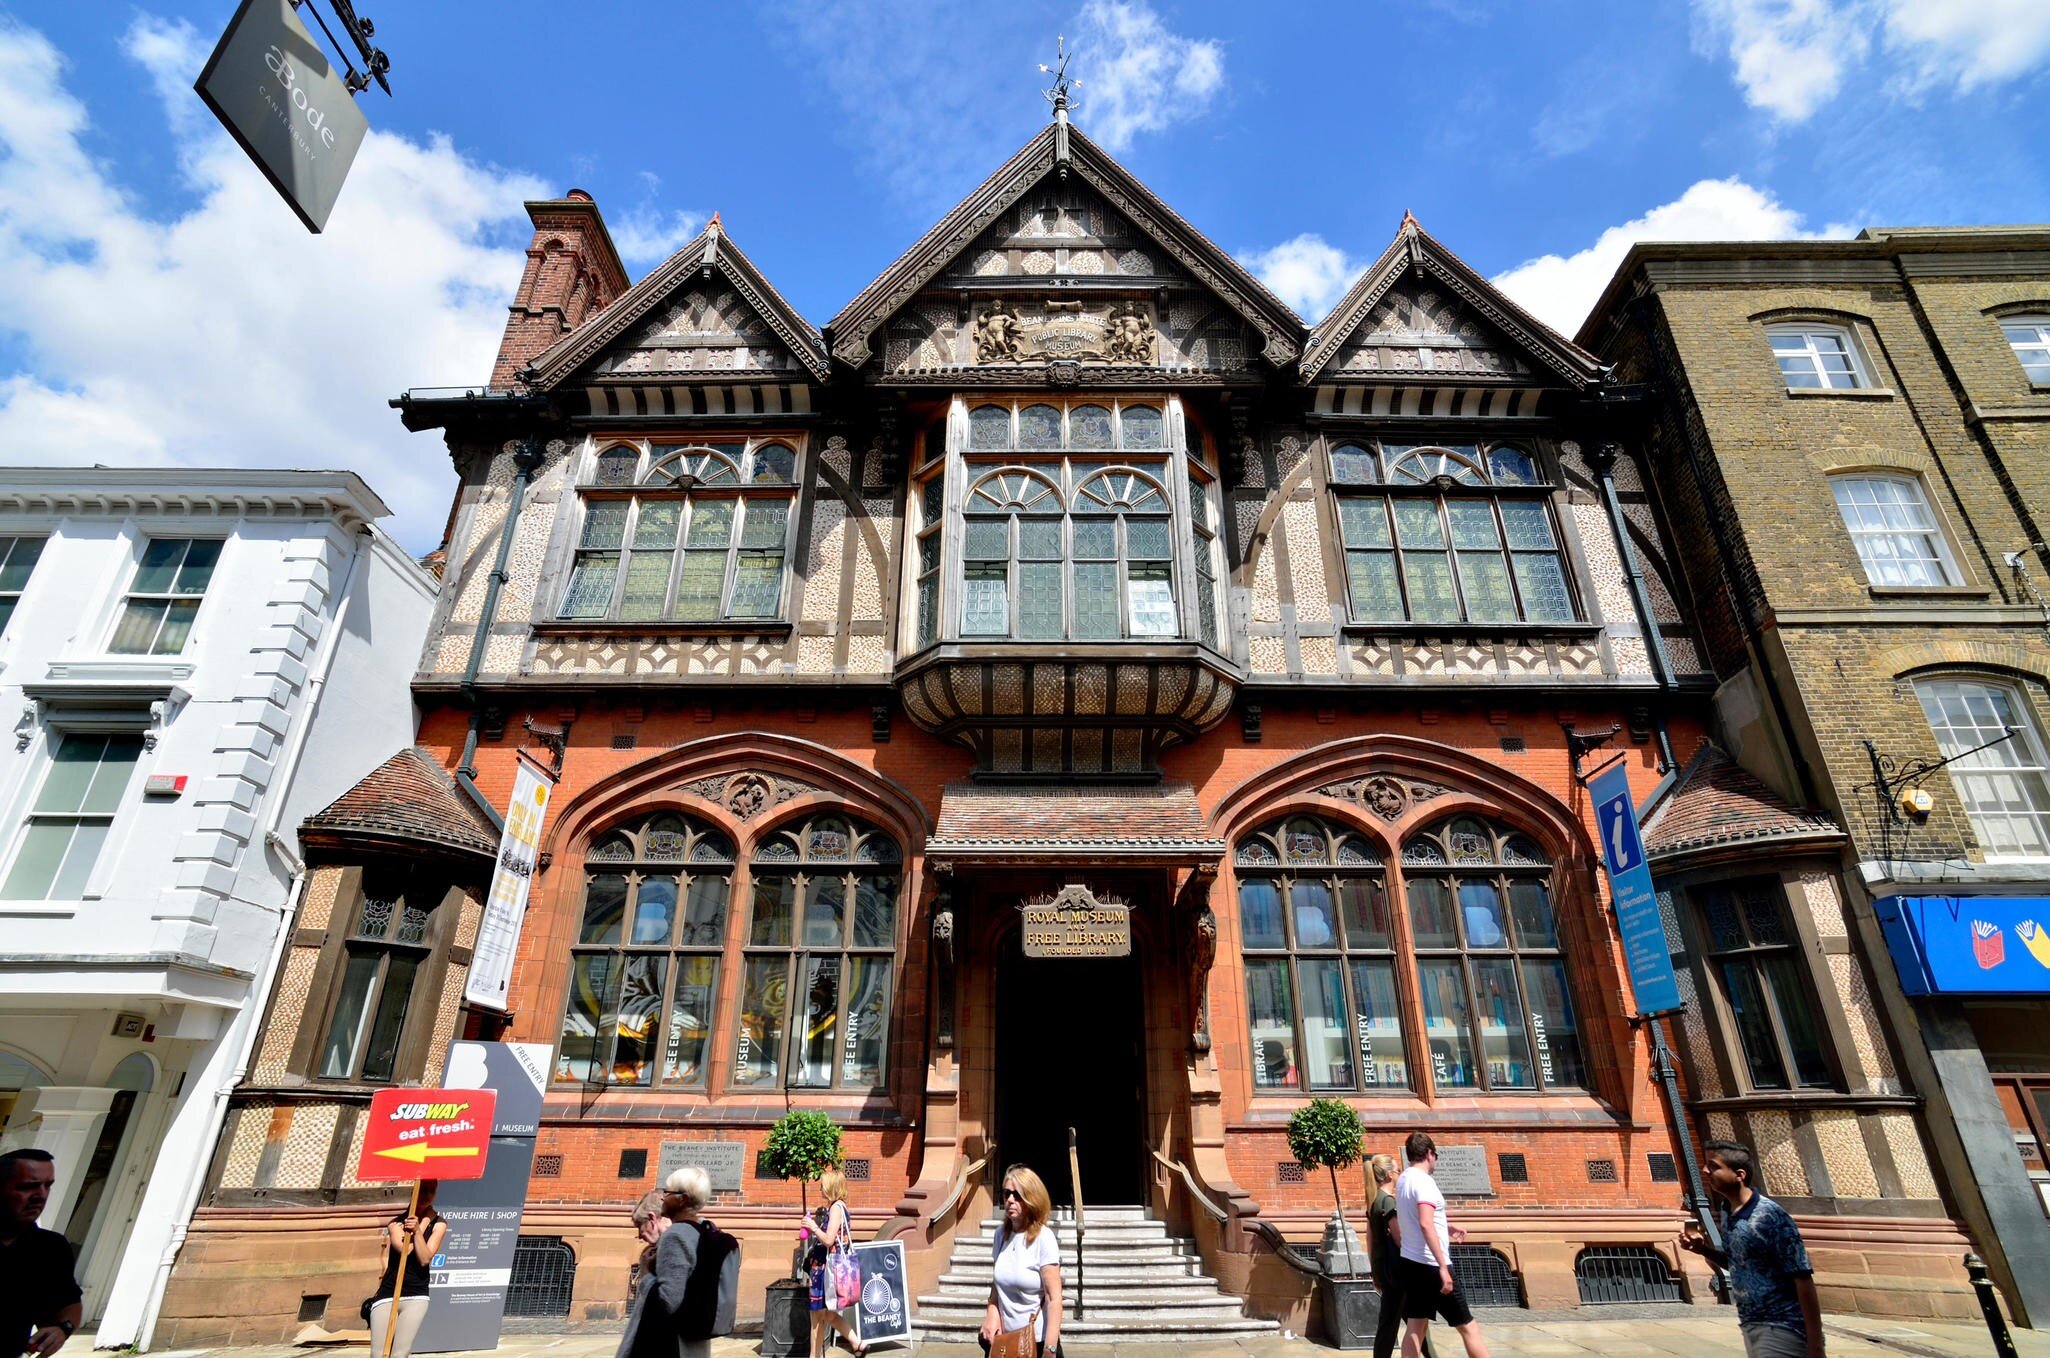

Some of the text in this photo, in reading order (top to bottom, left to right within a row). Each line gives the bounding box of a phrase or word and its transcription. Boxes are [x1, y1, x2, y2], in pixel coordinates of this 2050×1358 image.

[258, 85, 319, 161] CANTERBURY
[1031, 328, 1099, 344] PUBLIC LIBRARY
[1045, 341, 1082, 350] MUSEUM
[1027, 911, 1125, 924] ROYAL MUSEUM
[1066, 924, 1085, 932] AND
[1027, 932, 1061, 946] FREE
[669, 1010, 683, 1047] ENTRY
[846, 1011, 859, 1049] ENTRY
[736, 1027, 751, 1080] MUSEUM
[1357, 1013, 1376, 1083] FREE ENTRY
[1532, 1012, 1555, 1082] FREE ENTRY
[515, 1046, 545, 1084] FREE ENTRY
[390, 1102, 470, 1120] SUBWAY
[399, 1126, 426, 1140] eat
[501, 1124, 534, 1132] MUSEUM
[442, 1211, 518, 1220] VENUE HIRE SHOP
[864, 1316, 877, 1324] THE
